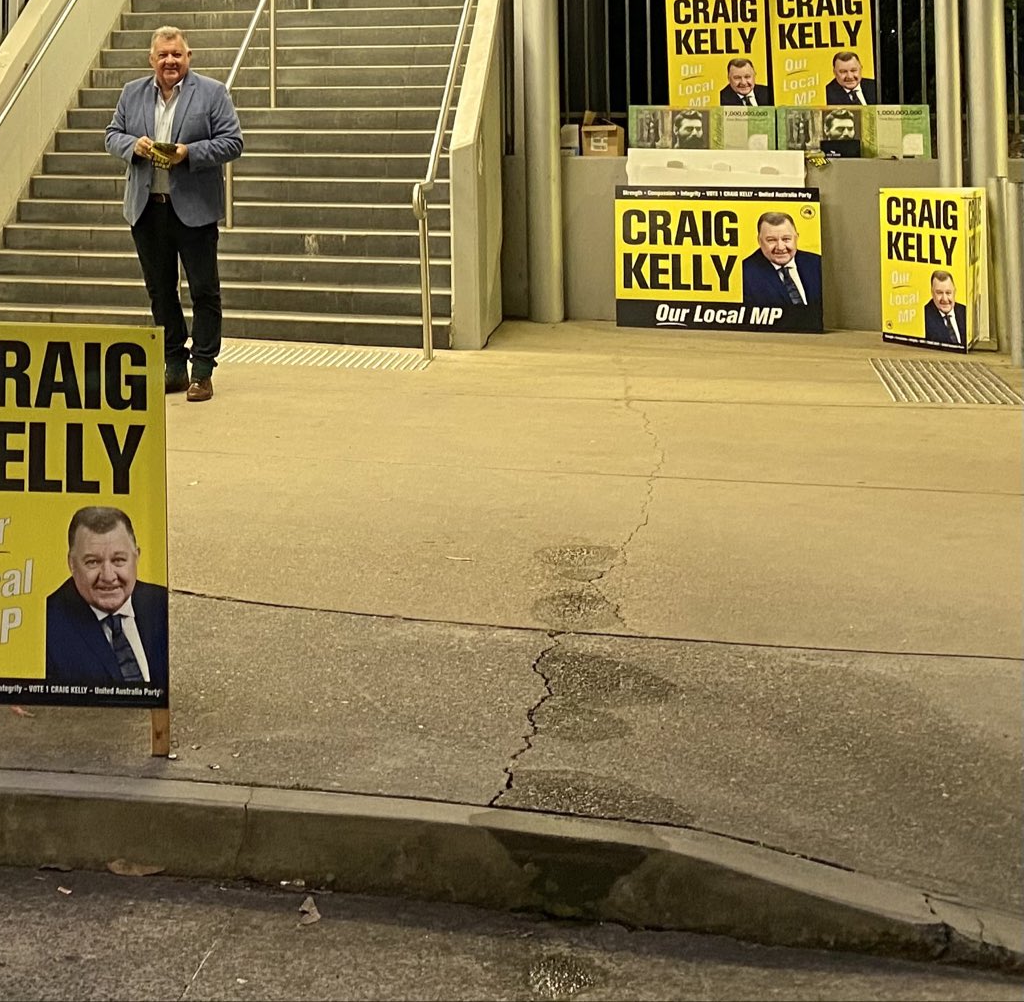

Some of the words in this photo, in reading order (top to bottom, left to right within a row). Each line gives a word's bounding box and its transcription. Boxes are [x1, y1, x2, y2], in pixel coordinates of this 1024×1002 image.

[675, 27, 756, 55] KELLY
[778, 20, 862, 50] KELLY
[680, 63, 703, 77] Our
[785, 58, 808, 72] Our
[678, 79, 714, 95] Local
[783, 73, 819, 92] Local
[688, 96, 711, 106] MP
[794, 91, 816, 105] MP
[886, 196, 958, 230] CRAIG
[622, 209, 738, 247] CRAIG
[887, 230, 957, 266] KELLY
[622, 252, 738, 292] KELLY
[891, 270, 910, 285] Our
[889, 291, 919, 306] Local
[655, 303, 690, 323] Our
[693, 304, 745, 324] Local
[750, 307, 783, 326] MP
[898, 309, 916, 324] MP
[28, 685, 44, 693] VOTE
[50, 685, 70, 694] CRAIG
[70, 686, 88, 694] KELLY
[94, 687, 115, 695] United
[115, 687, 143, 696] Australia
[143, 688, 161, 698] Party
